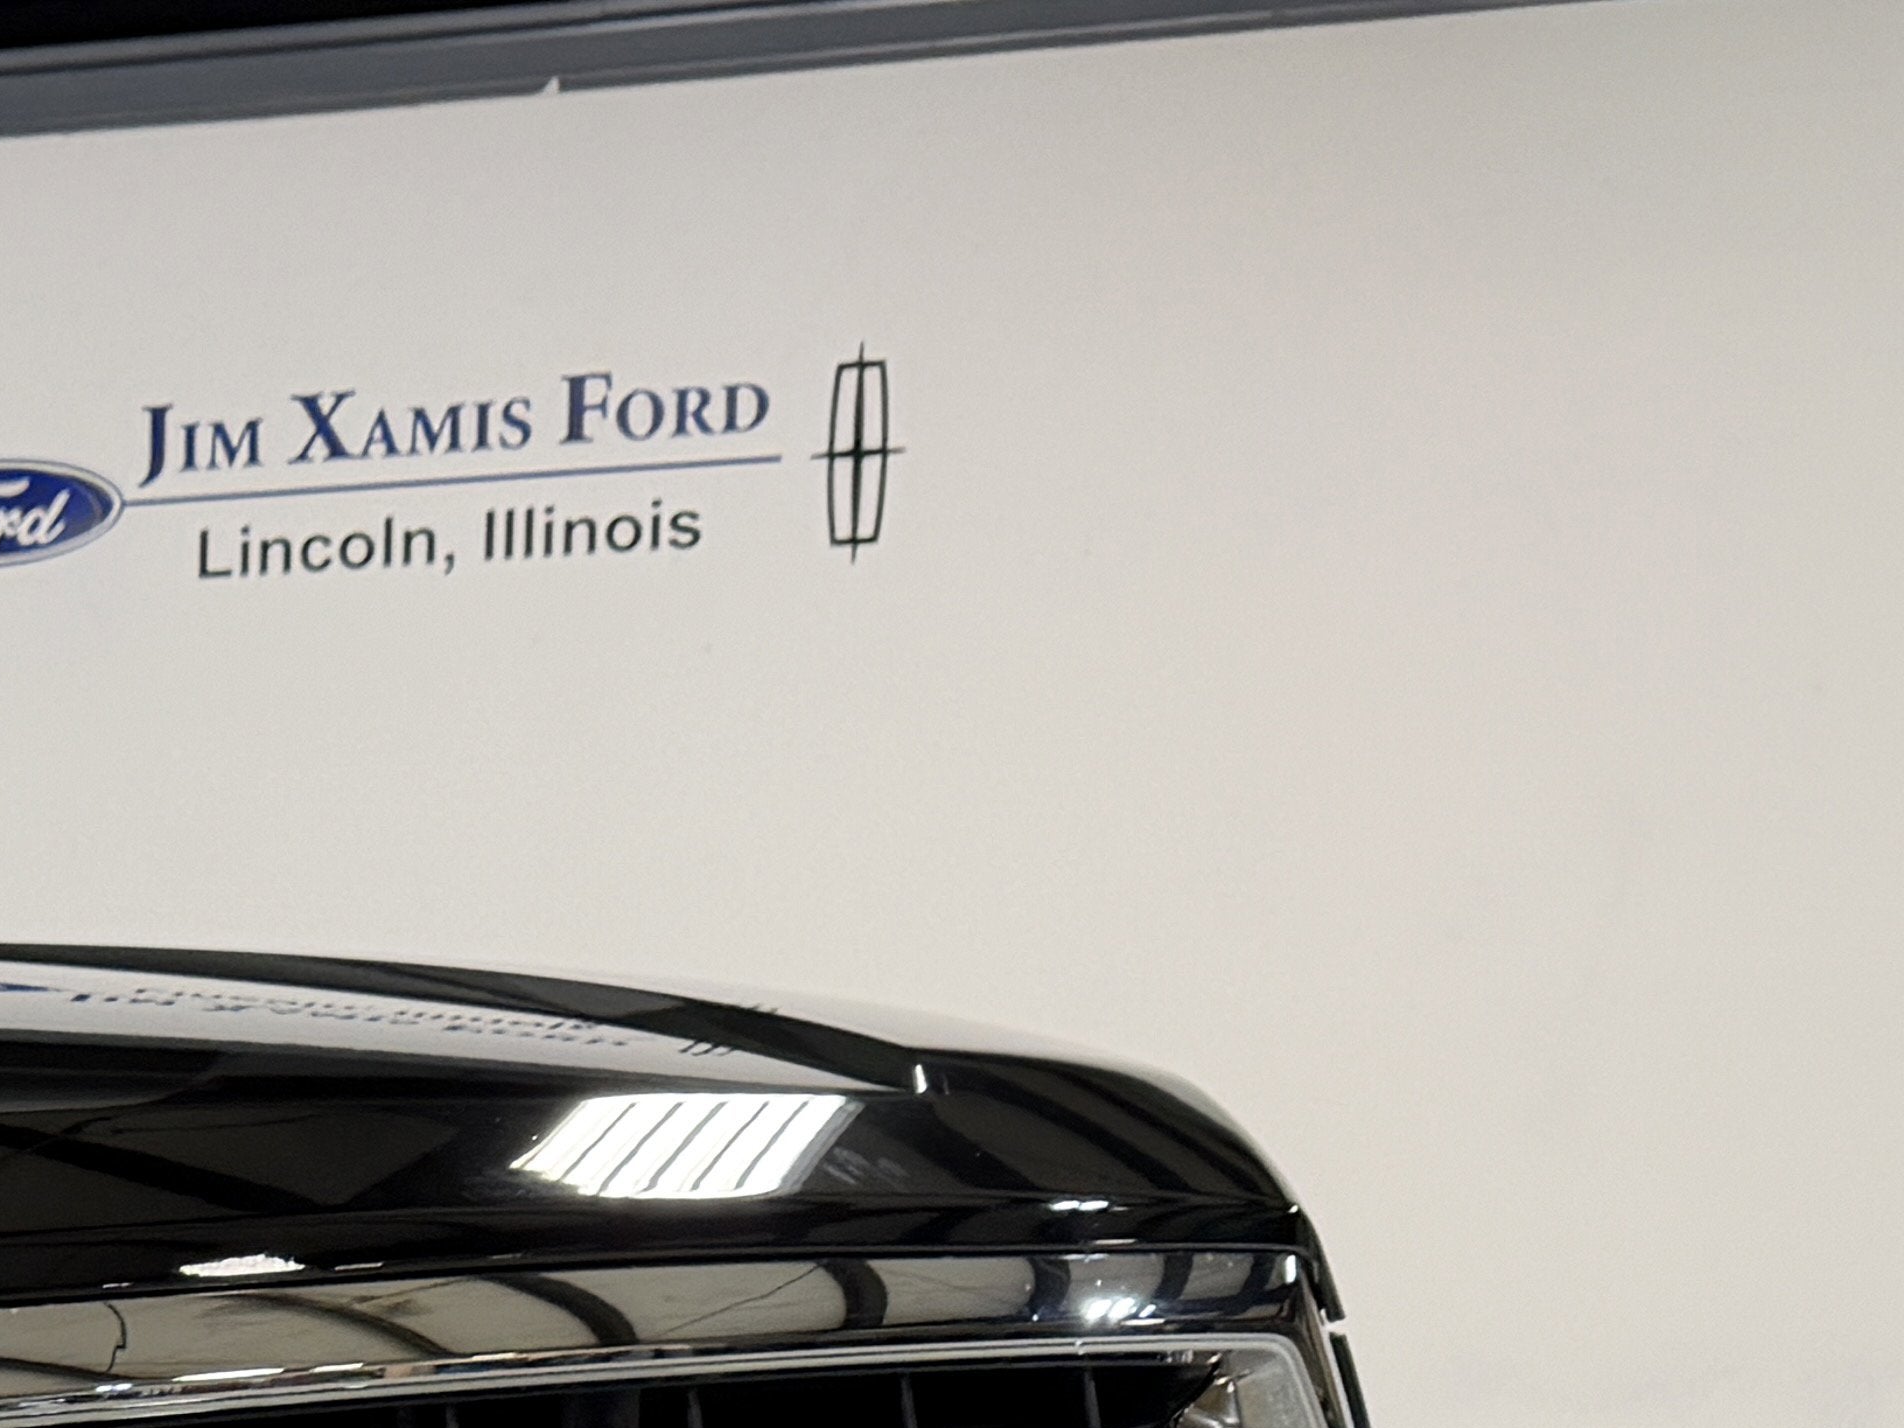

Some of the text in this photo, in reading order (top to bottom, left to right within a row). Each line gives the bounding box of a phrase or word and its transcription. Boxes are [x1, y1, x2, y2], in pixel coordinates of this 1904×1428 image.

[138, 371, 771, 488] JIM XAMIS FORD
[197, 497, 703, 579] Lincoln, Illinois
